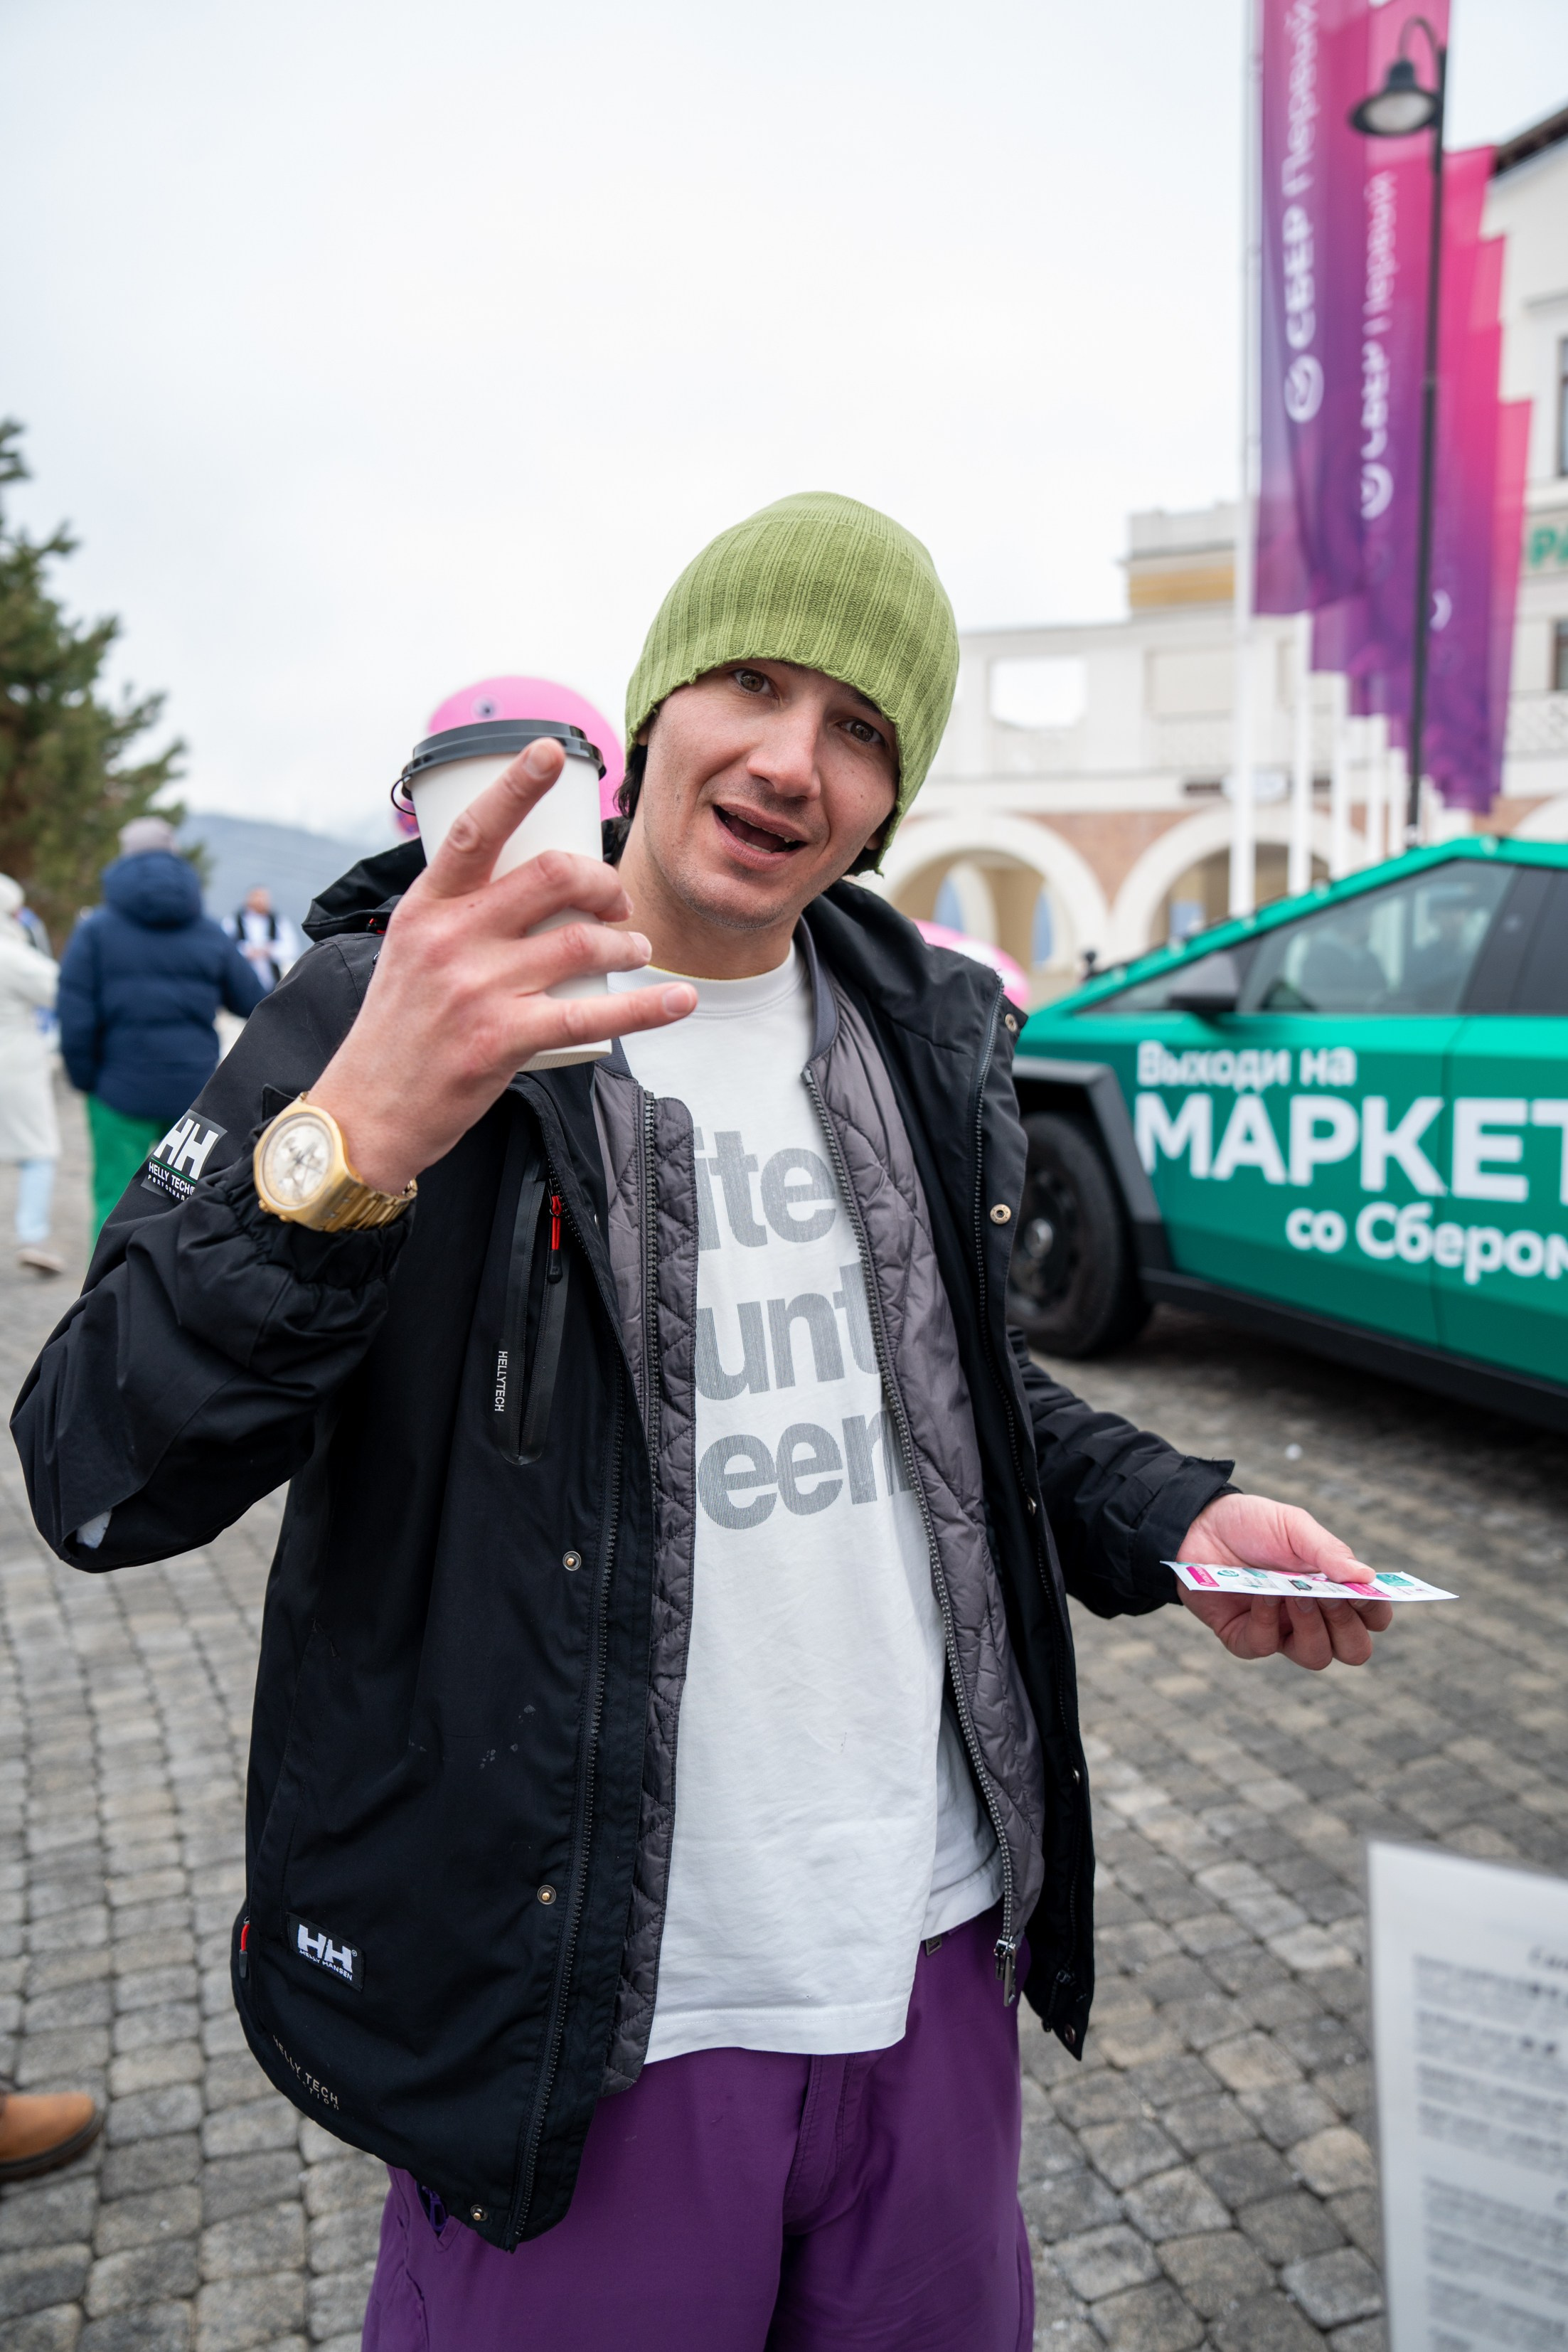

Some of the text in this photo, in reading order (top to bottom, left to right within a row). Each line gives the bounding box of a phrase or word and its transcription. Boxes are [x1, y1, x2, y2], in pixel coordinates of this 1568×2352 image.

[1136, 1039, 1357, 1094] Выходи на
[148, 1161, 169, 1182] HELLY
[1285, 1208, 1347, 1254] со
[494, 1351, 508, 1412] HELLYTECH
[297, 1924, 353, 1973] HH
[299, 1949, 353, 1981] HELLY HANSEN
[272, 2035, 338, 2104] HELLY TECH
